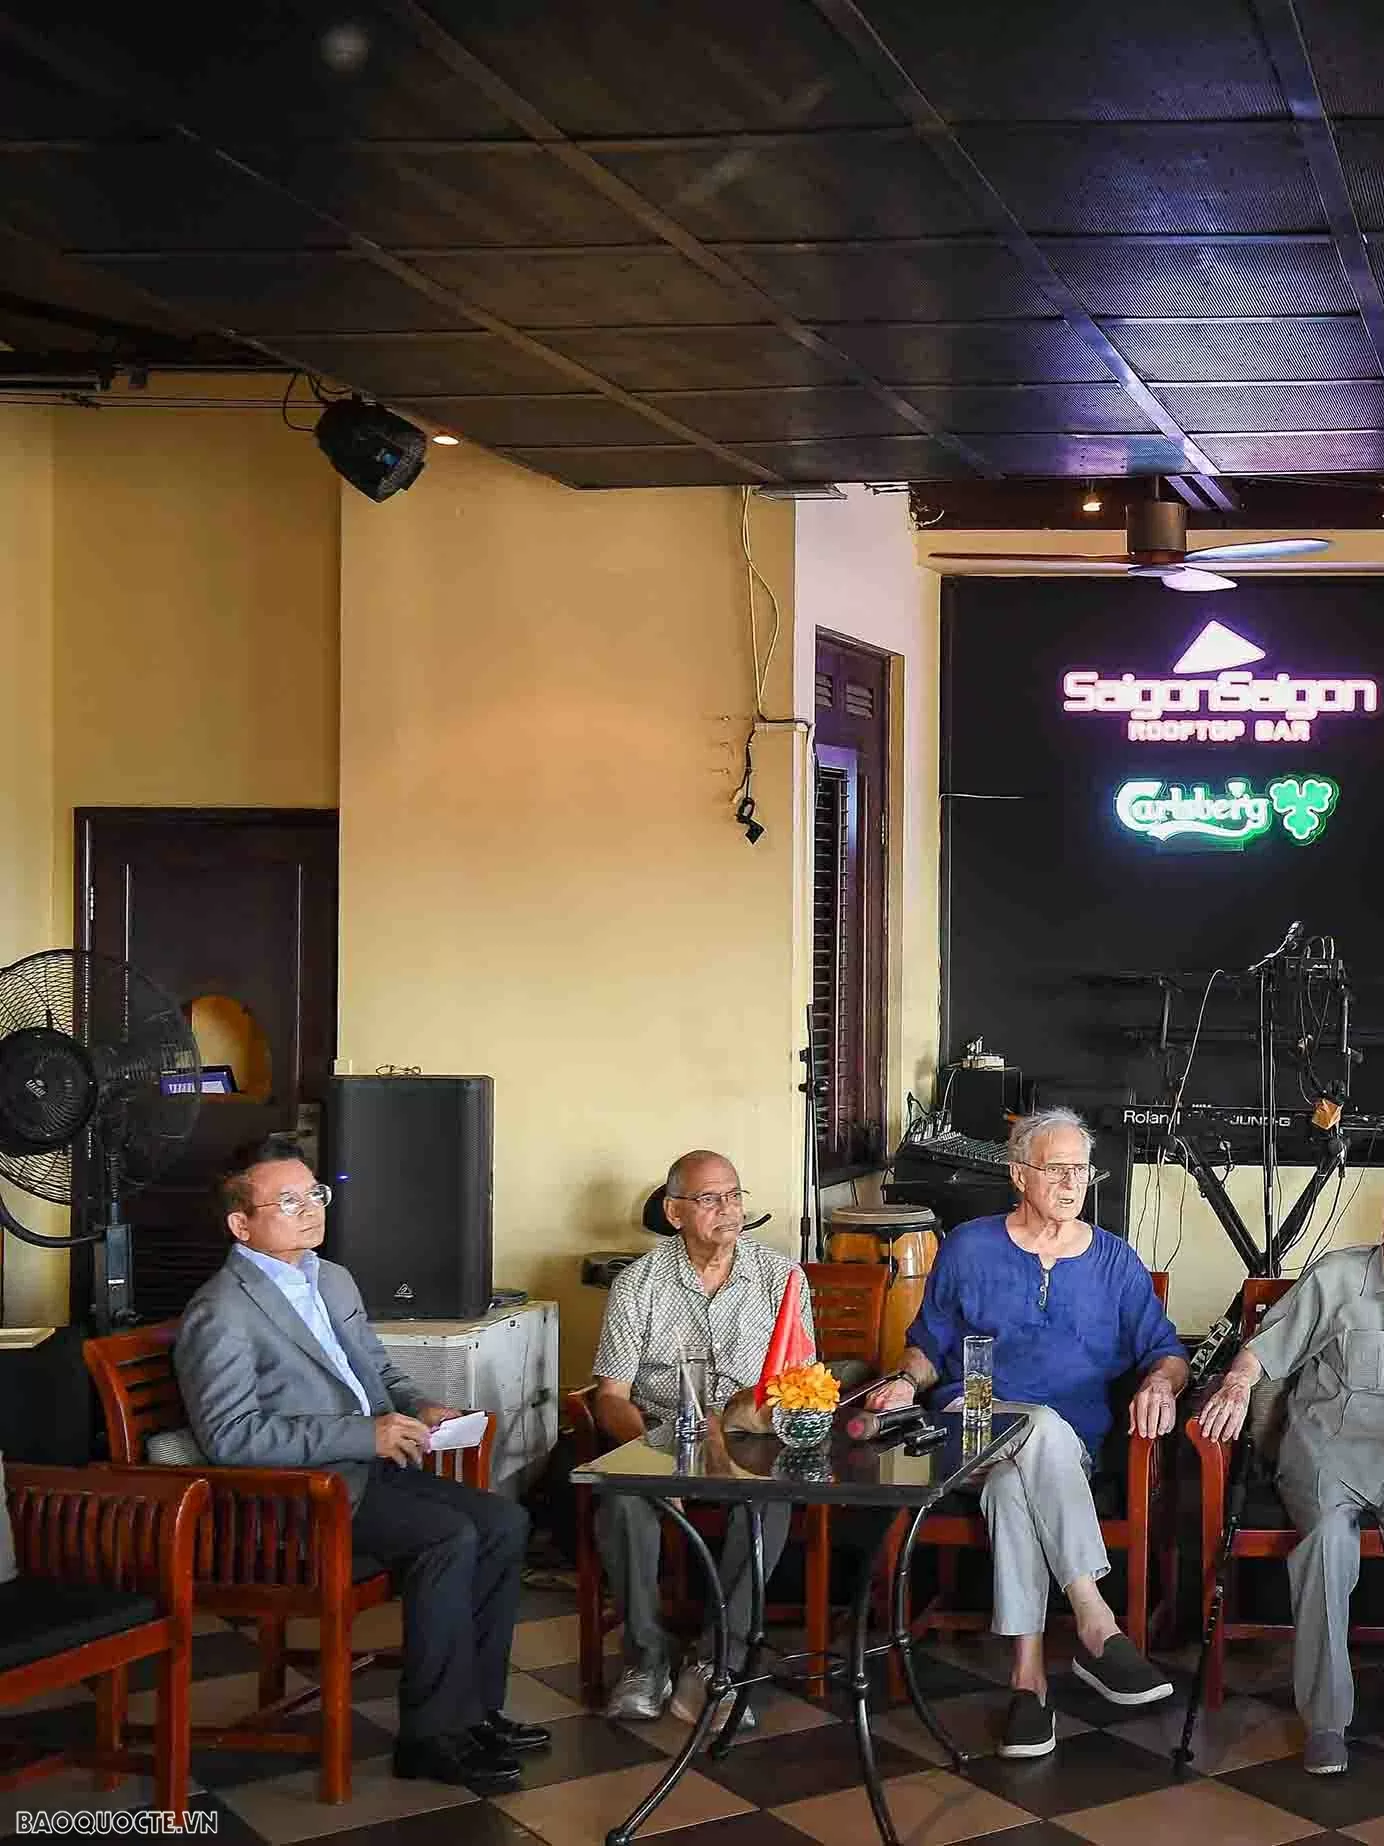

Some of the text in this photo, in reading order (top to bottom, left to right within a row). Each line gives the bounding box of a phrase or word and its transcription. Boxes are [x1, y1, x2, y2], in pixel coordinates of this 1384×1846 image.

[1128, 720, 1311, 741] ROOFTOP BAR
[1116, 781, 1268, 841] Carlsberg
